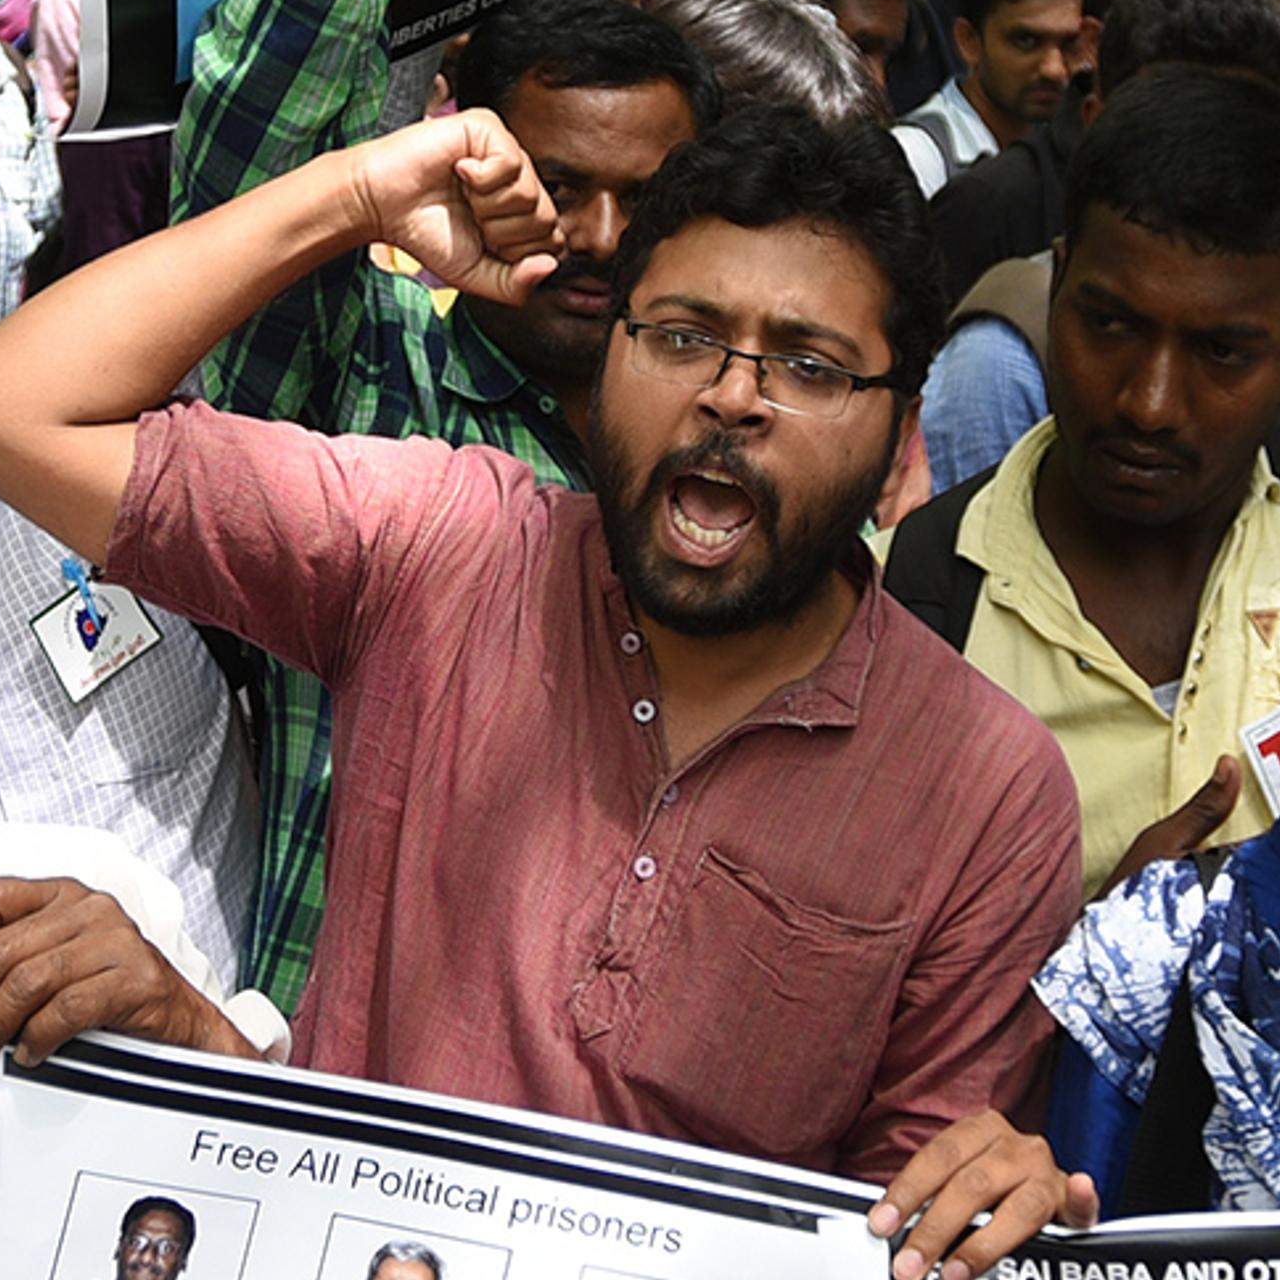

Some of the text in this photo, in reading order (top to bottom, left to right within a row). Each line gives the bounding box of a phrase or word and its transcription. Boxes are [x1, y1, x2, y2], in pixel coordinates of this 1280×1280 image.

[190, 1129, 684, 1255] Free All Political prisoners
